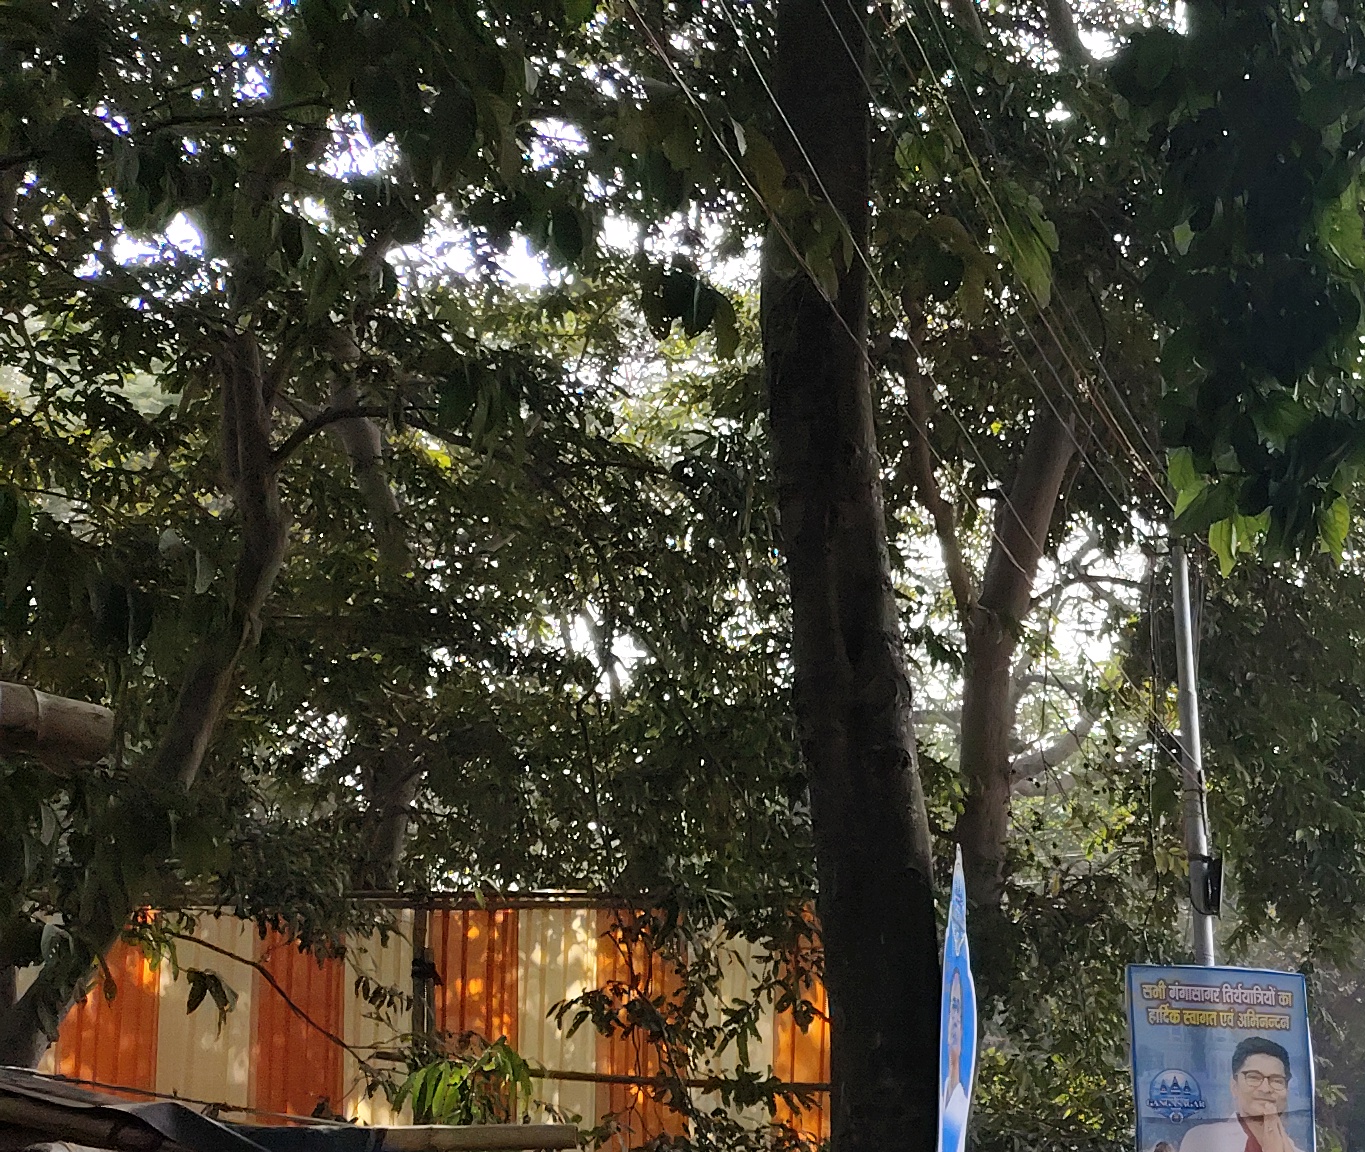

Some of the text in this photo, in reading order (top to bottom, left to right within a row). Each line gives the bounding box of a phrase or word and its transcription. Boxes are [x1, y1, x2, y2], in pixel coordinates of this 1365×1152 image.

[1141, 980, 1167, 1000] सभी
[1168, 983, 1220, 1003] गंगासागर
[1278, 991, 1293, 1007] का
[1148, 1003, 1290, 1030] हार्दिक स्वागत एवं अभिनन्दन
